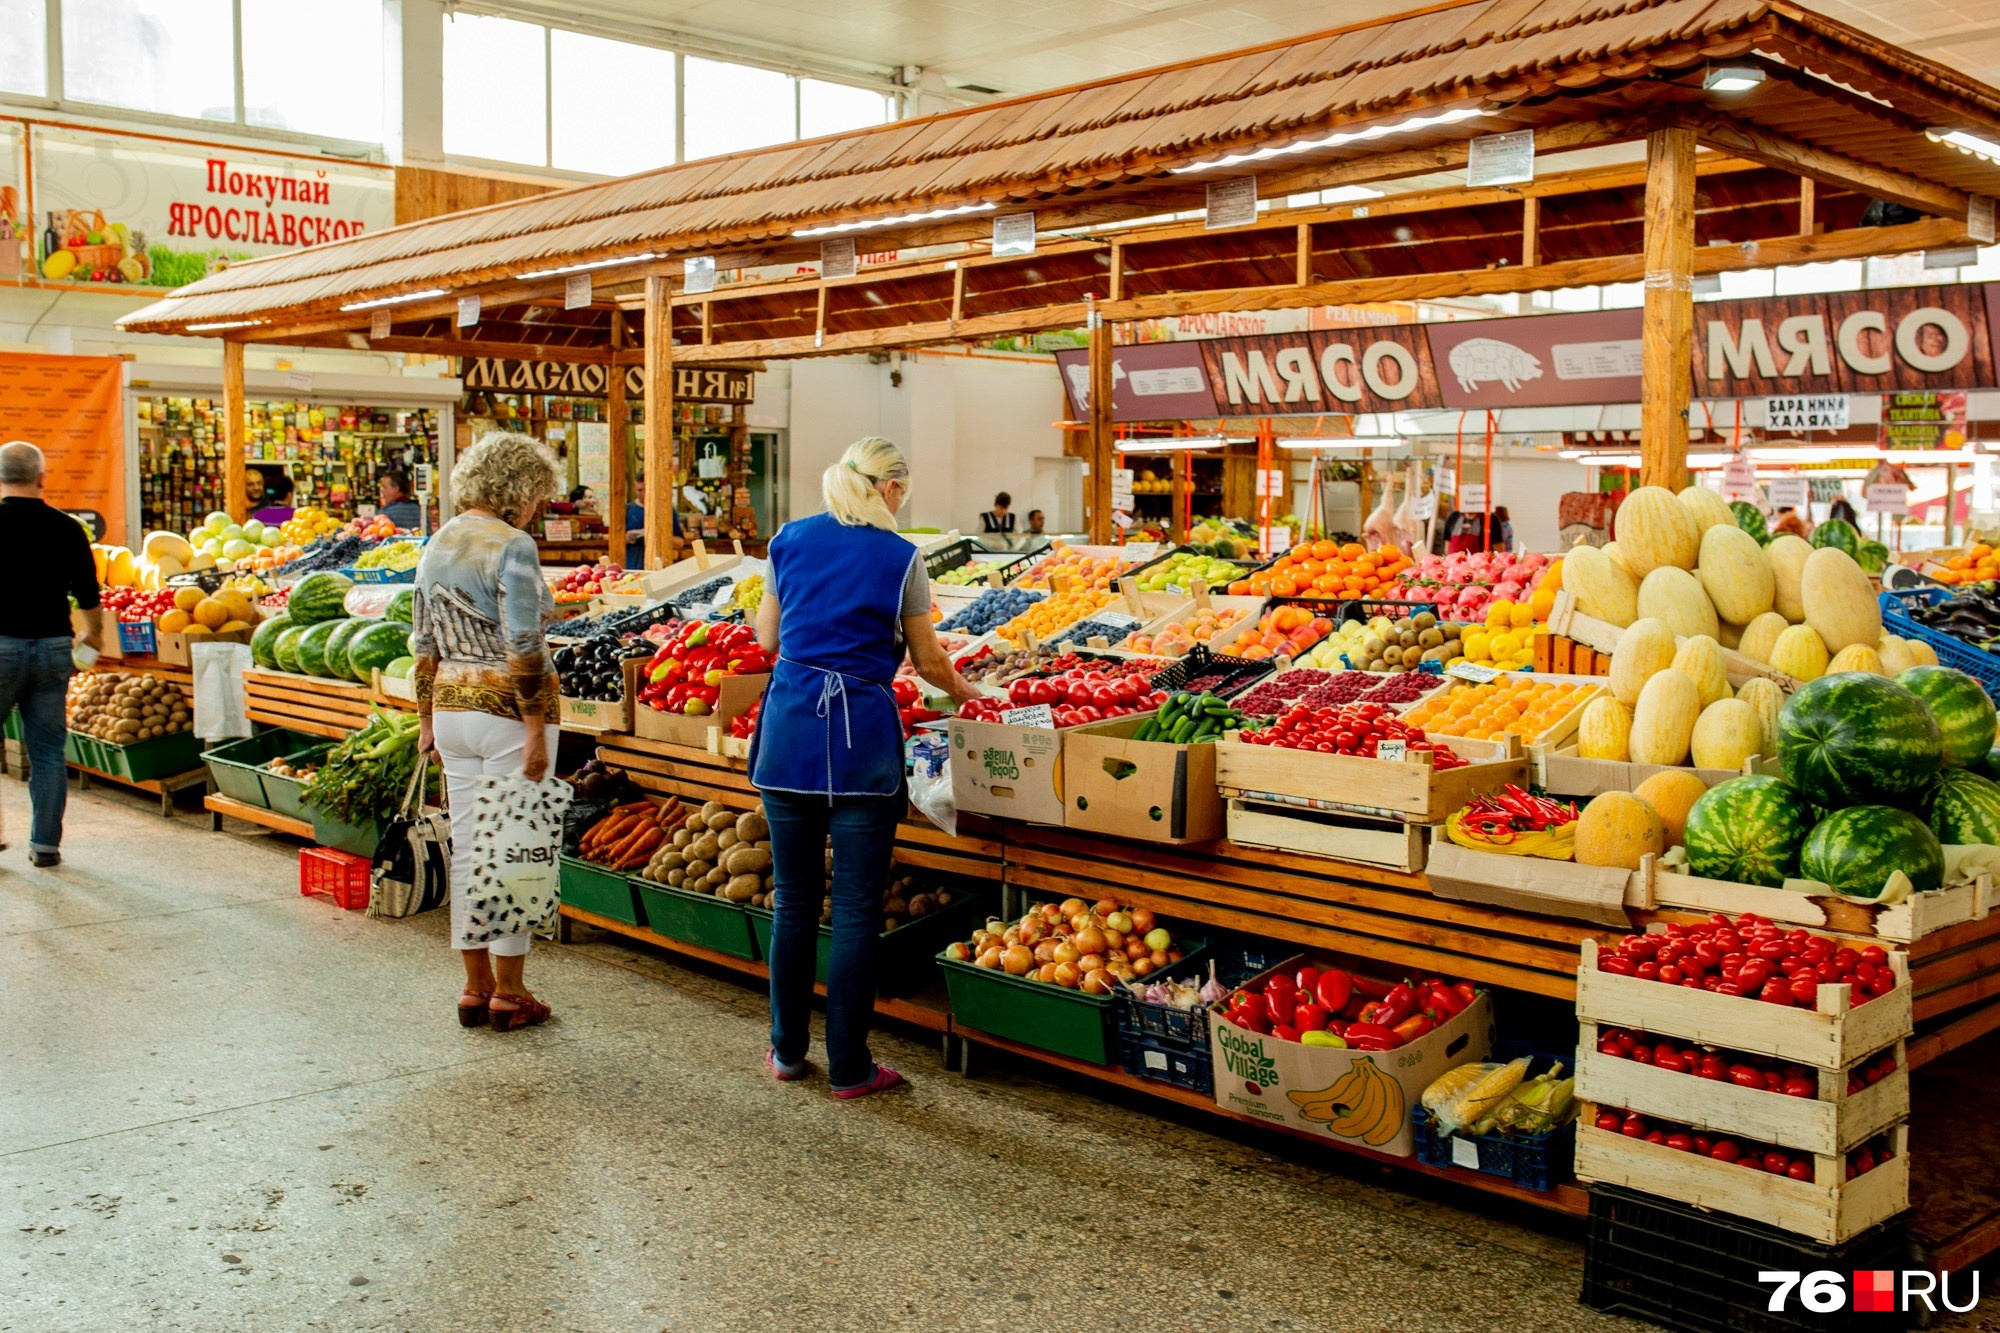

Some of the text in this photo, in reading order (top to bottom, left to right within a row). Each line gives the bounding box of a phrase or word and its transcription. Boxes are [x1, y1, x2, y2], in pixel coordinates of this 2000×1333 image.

[206, 159, 330, 208] Покупай
[1706, 307, 1969, 381] МЯСО
[1221, 340, 1419, 406] МЯСО
[1769, 397, 1844, 412] БАРАНИНА
[983, 747, 1017, 766] Village
[989, 765, 1020, 780] Global
[1217, 1025, 1265, 1058] Global
[1222, 1048, 1279, 1088] Village
[1229, 1092, 1268, 1110] Premium
[1246, 1106, 1285, 1121] bananas
